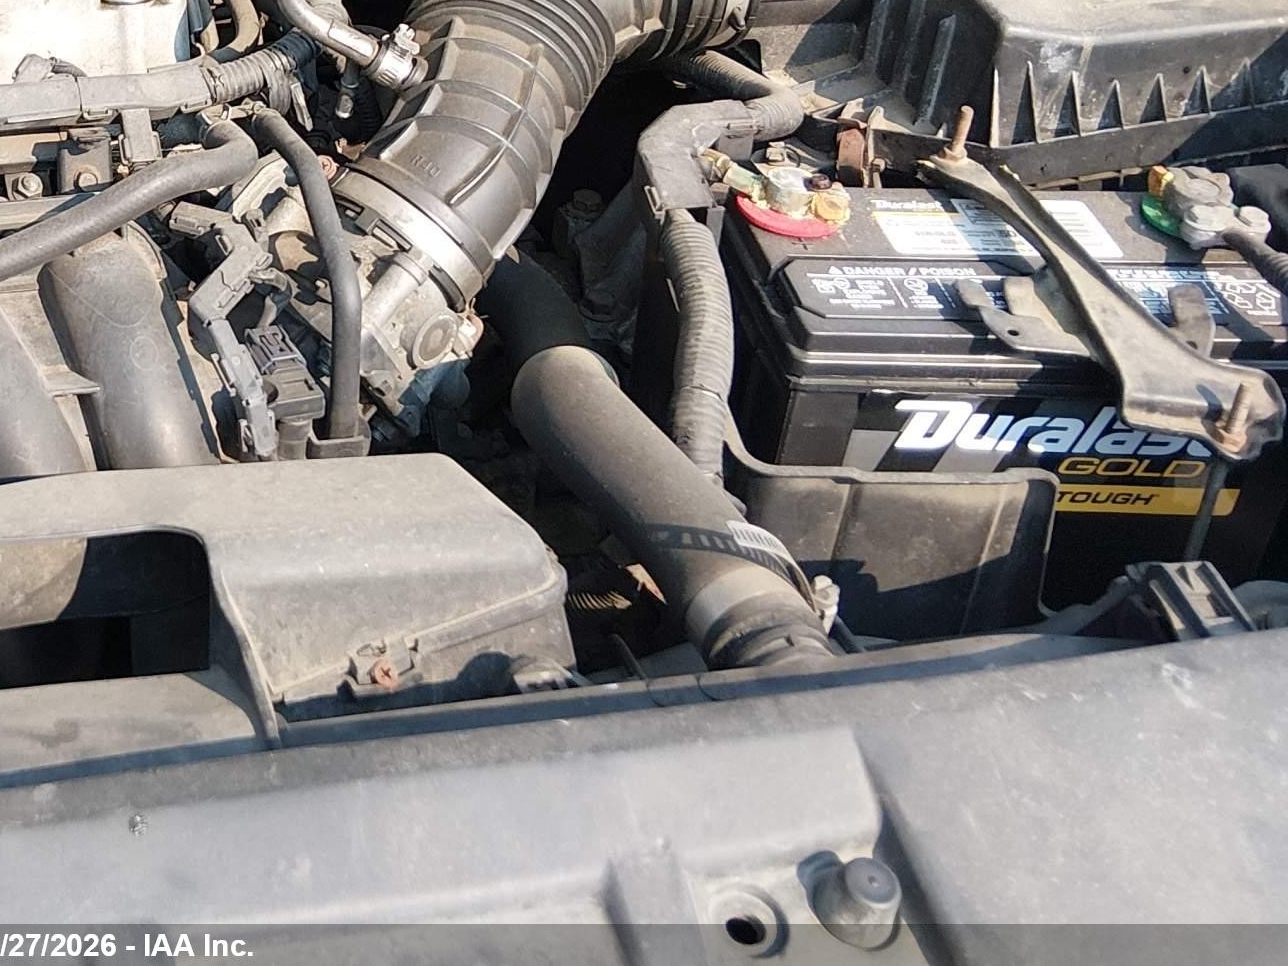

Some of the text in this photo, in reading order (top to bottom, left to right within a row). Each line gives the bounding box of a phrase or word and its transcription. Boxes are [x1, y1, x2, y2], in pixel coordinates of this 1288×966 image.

[842, 266, 906, 276] DANGER
[917, 267, 977, 276] POISON
[1057, 456, 1207, 479] GOLD
[1057, 490, 1155, 506] TOUGH
